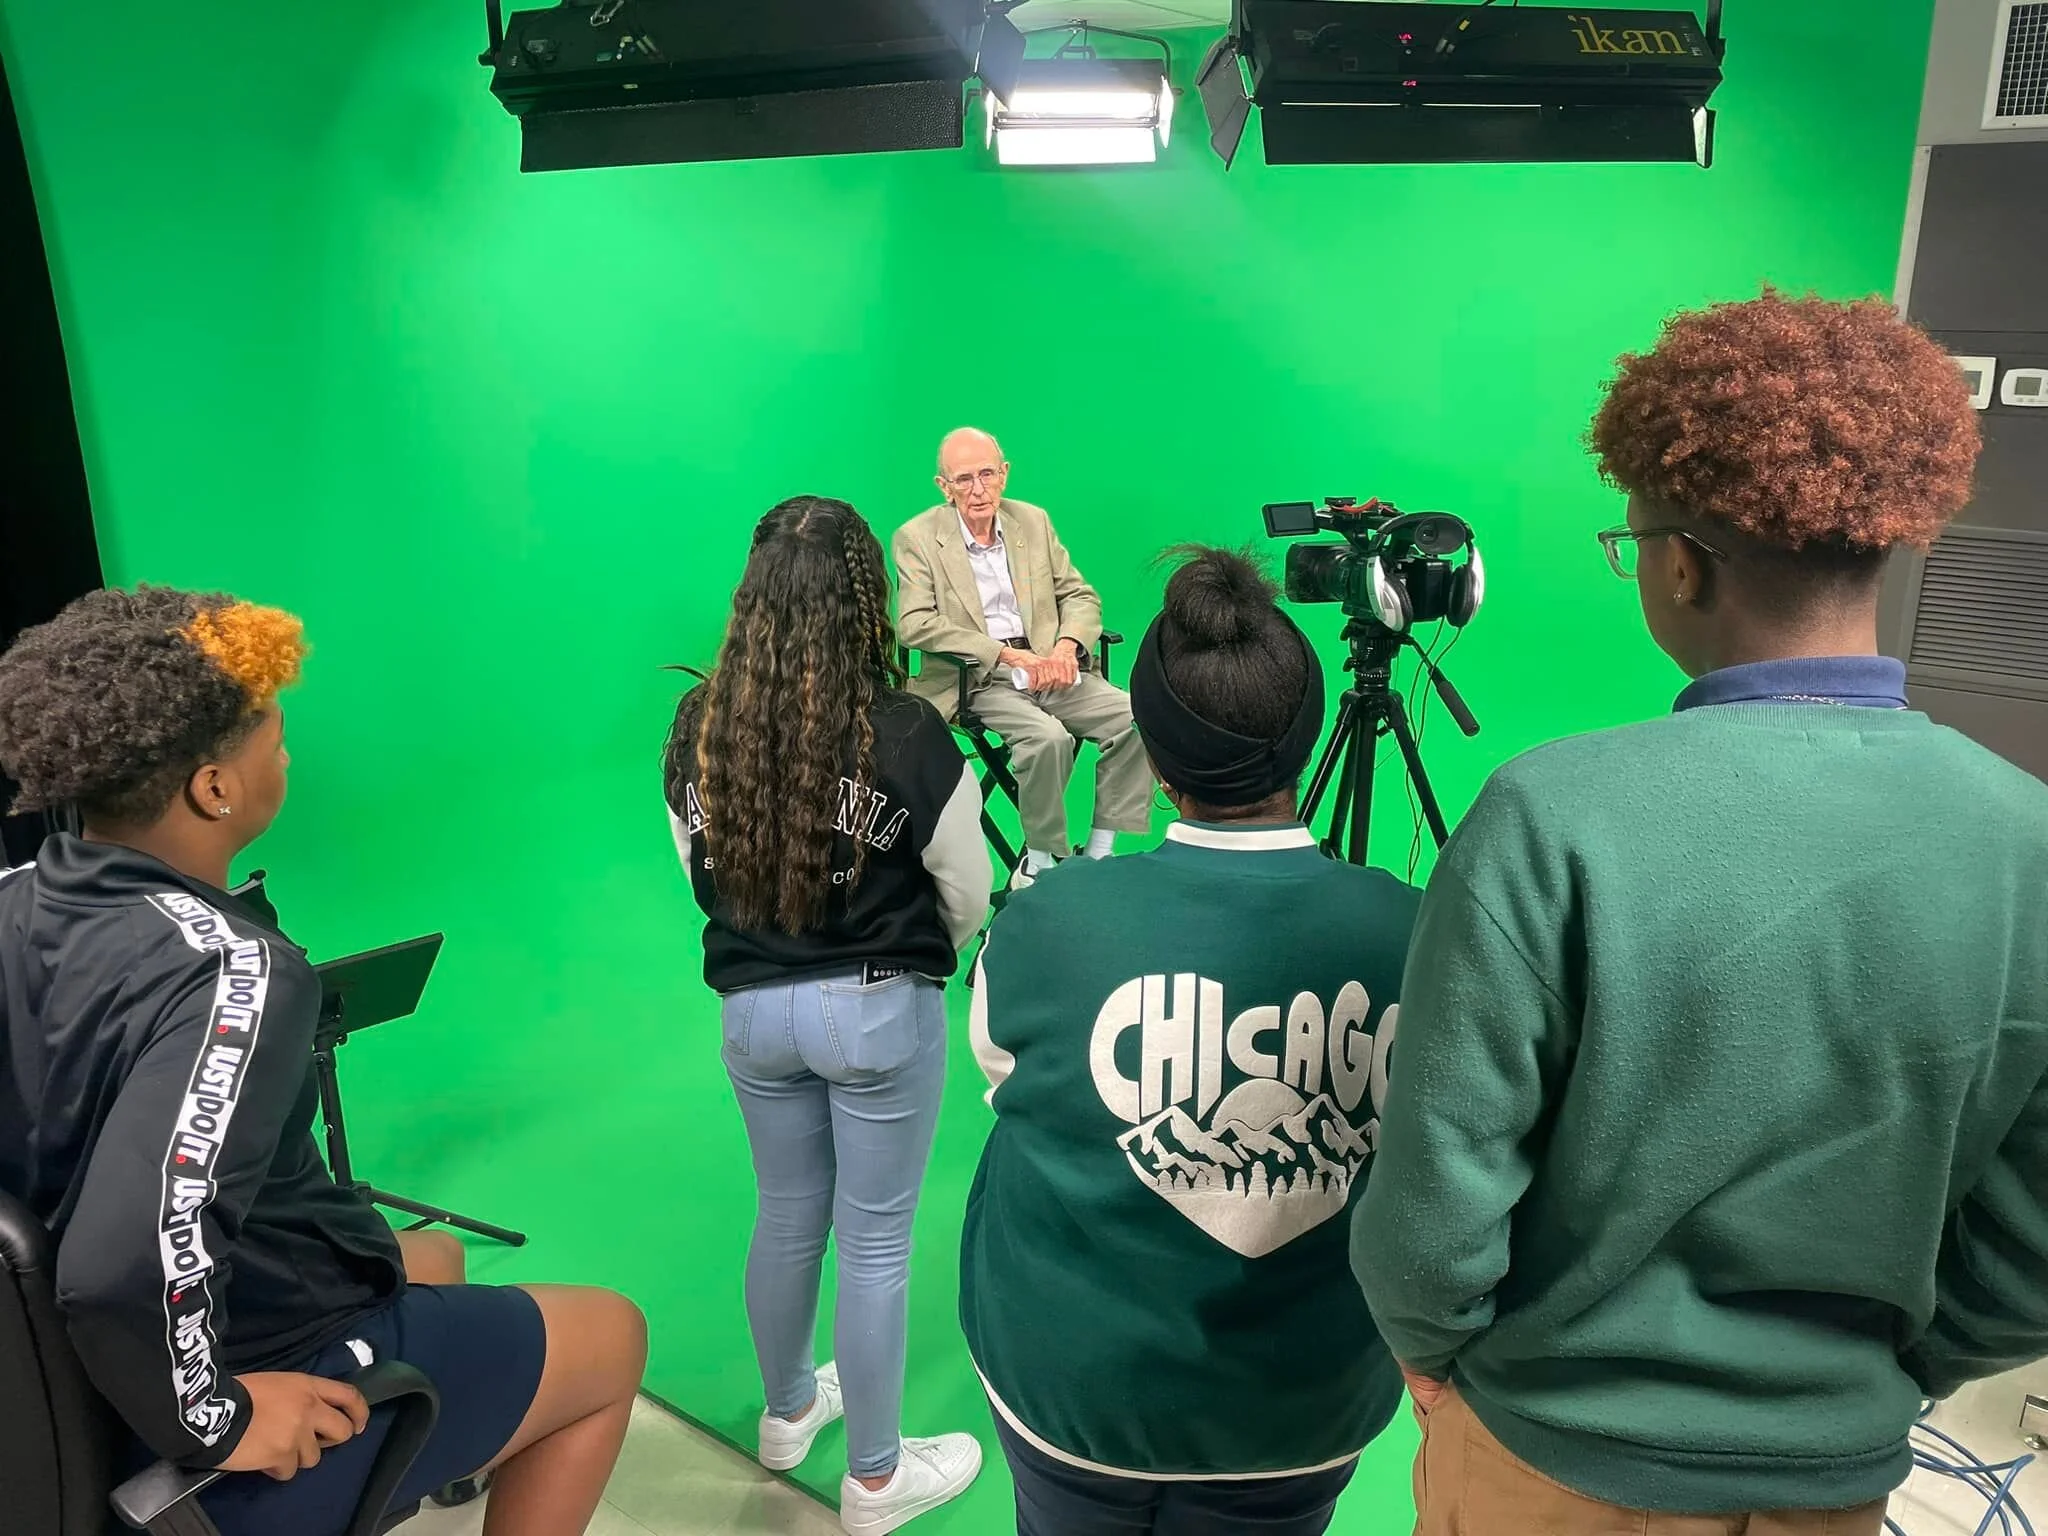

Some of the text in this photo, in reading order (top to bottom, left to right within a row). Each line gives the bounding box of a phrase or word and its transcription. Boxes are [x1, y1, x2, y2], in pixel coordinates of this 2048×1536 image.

[1567, 14, 1688, 54] ikan
[190, 918, 228, 945] DO
[226, 978, 258, 1005] DO
[198, 1044, 244, 1098] JUST
[189, 1097, 226, 1135] DO
[168, 1175, 208, 1225] UST
[169, 1227, 200, 1272] DO
[175, 1307, 210, 1361] JUST
